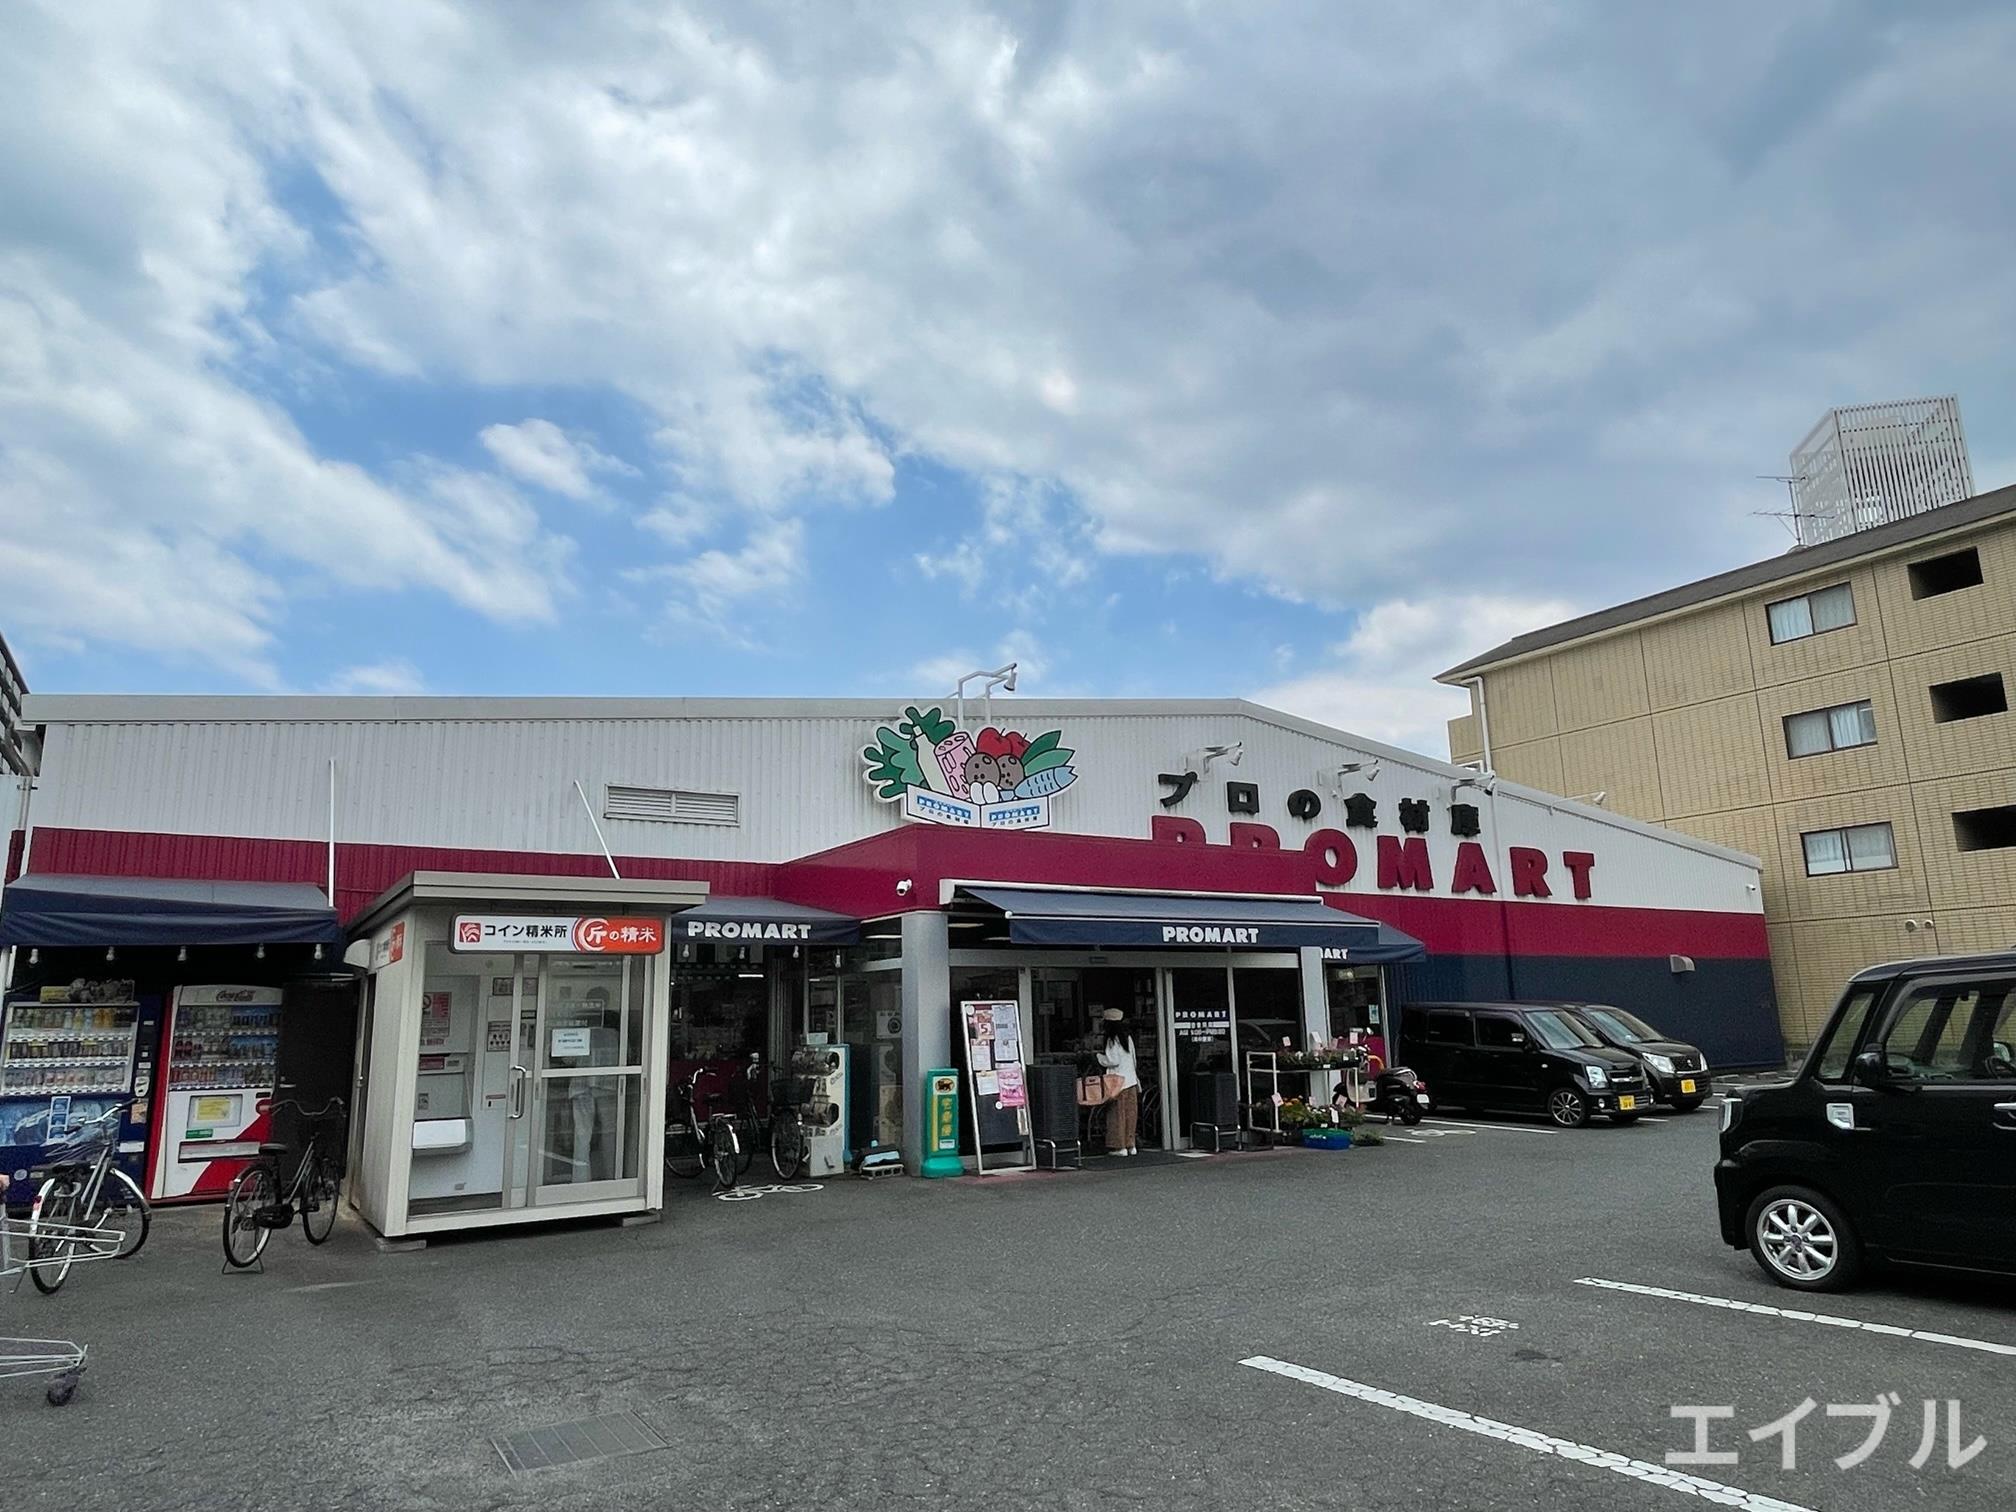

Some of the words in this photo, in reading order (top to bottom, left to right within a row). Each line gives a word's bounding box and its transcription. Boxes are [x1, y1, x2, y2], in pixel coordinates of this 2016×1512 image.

[484, 924, 567, 938] コイン精米所
[687, 921, 811, 938] PROMART
[1162, 926, 1259, 943] PROMART
[1320, 947, 1348, 960] ART
